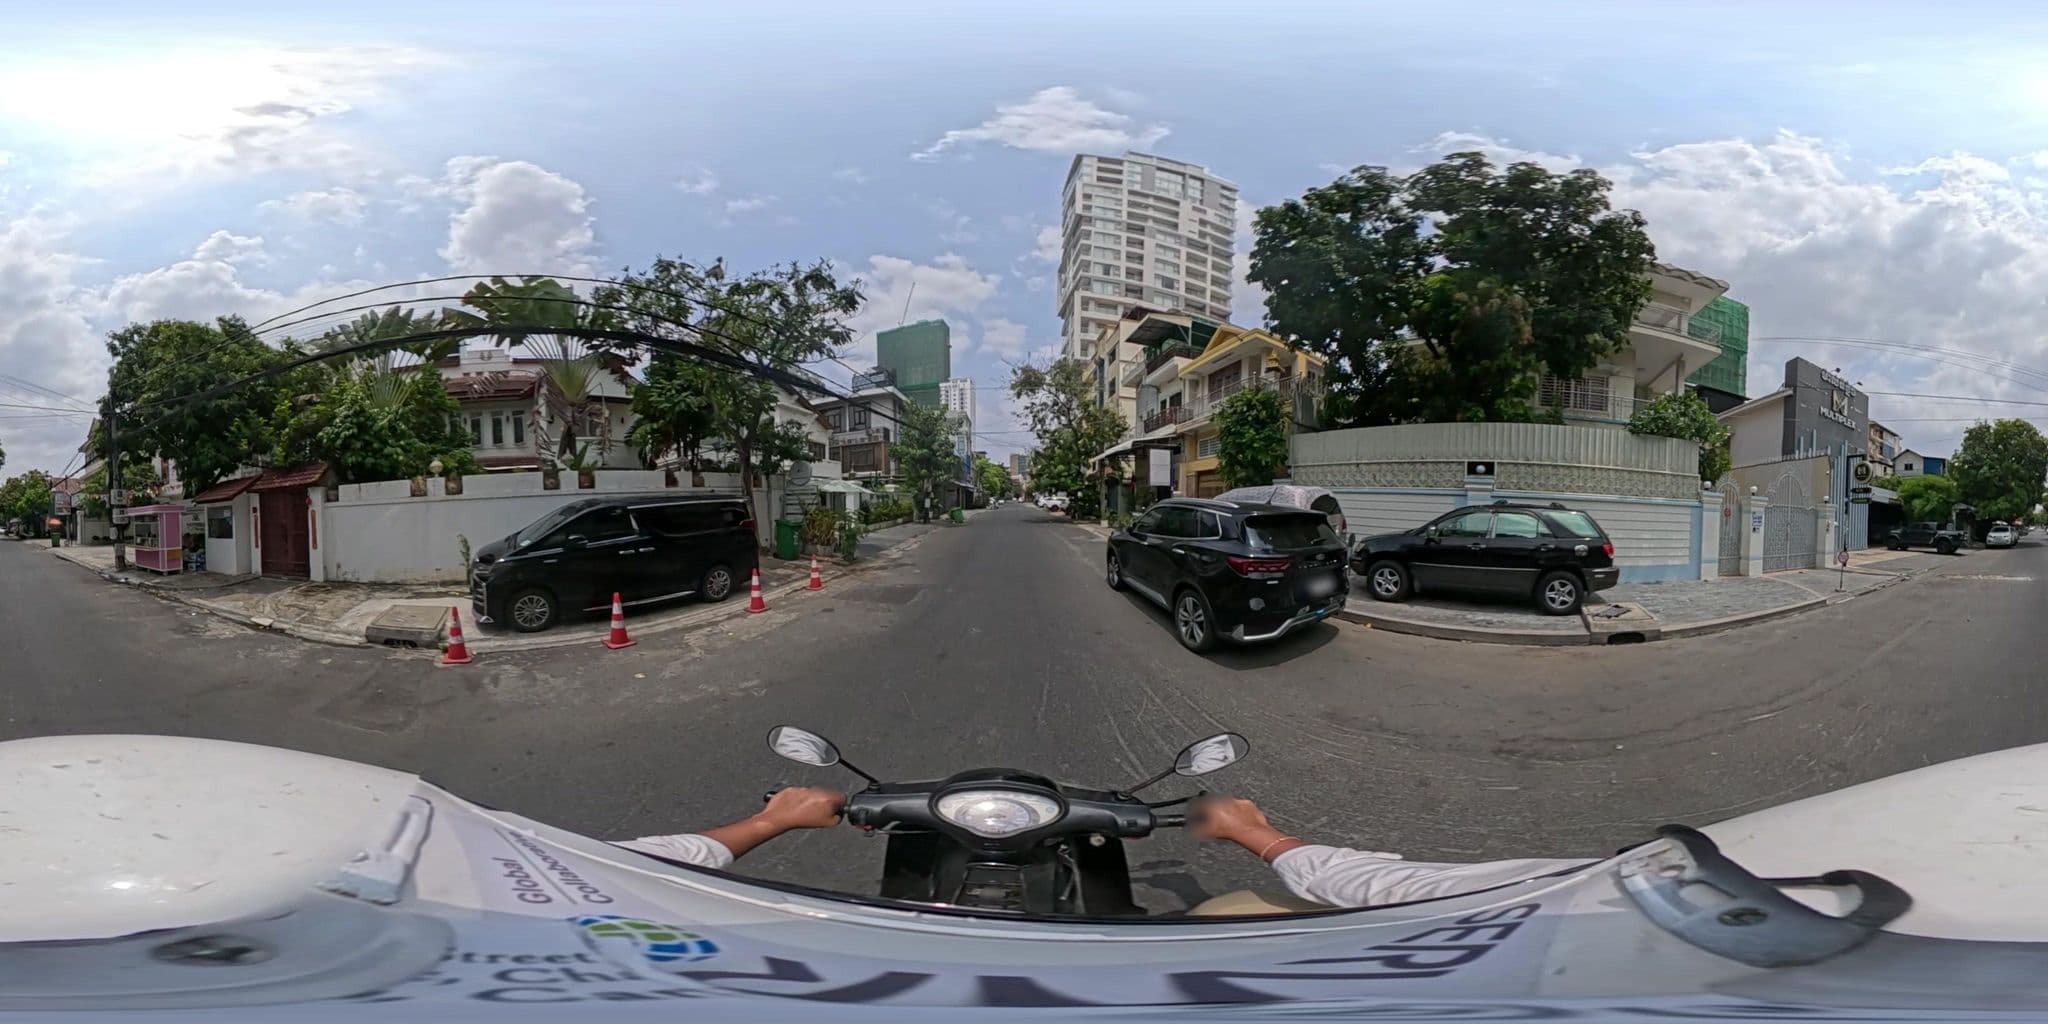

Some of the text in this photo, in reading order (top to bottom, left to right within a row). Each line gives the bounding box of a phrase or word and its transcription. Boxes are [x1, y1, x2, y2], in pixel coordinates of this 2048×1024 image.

[1820, 406, 1856, 429] MULTIPLEX
[491, 857, 553, 904] Global
[509, 831, 614, 904] Collaborative
